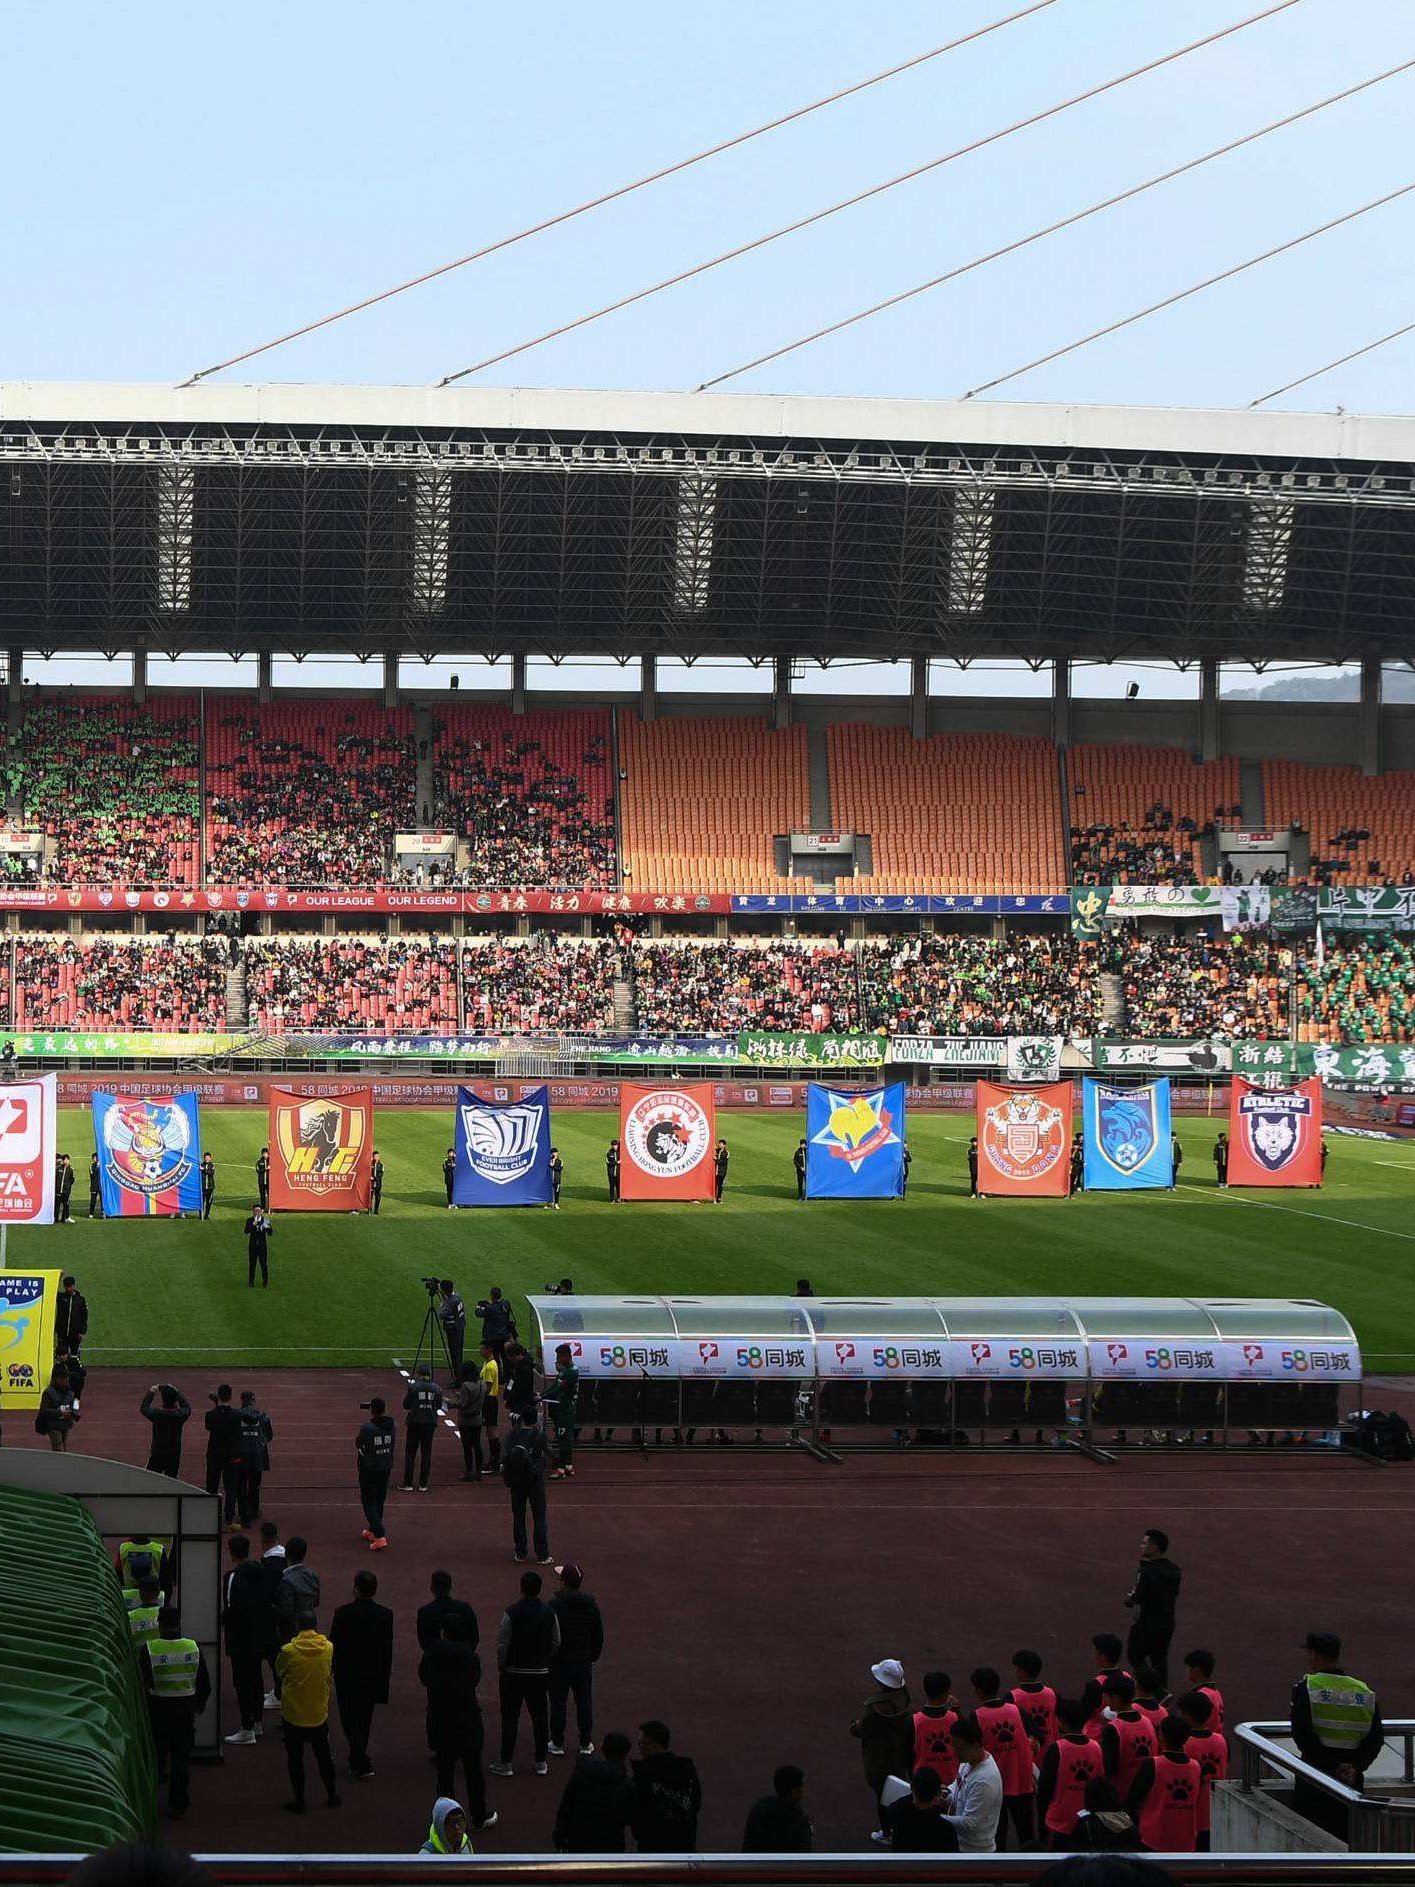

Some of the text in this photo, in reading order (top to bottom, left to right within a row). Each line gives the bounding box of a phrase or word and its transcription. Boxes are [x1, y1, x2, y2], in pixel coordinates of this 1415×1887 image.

[306, 896, 375, 906] OUR LEAGUE
[388, 896, 458, 906] OUR LEGEND
[895, 1040, 934, 1061] FORZA
[301, 1085, 316, 1096] 58
[551, 1086, 566, 1097] 58
[592, 1086, 619, 1097] 2019
[1355, 1084, 1395, 1093] POWER
[1242, 1096, 1306, 1109] ATHLETIC
[475, 1158, 528, 1170] FOOTBALL CLUB
[293, 1174, 348, 1182] HENG FENG
[6, 1288, 38, 1297] PLAY
[9, 1379, 34, 1388] FIFA
